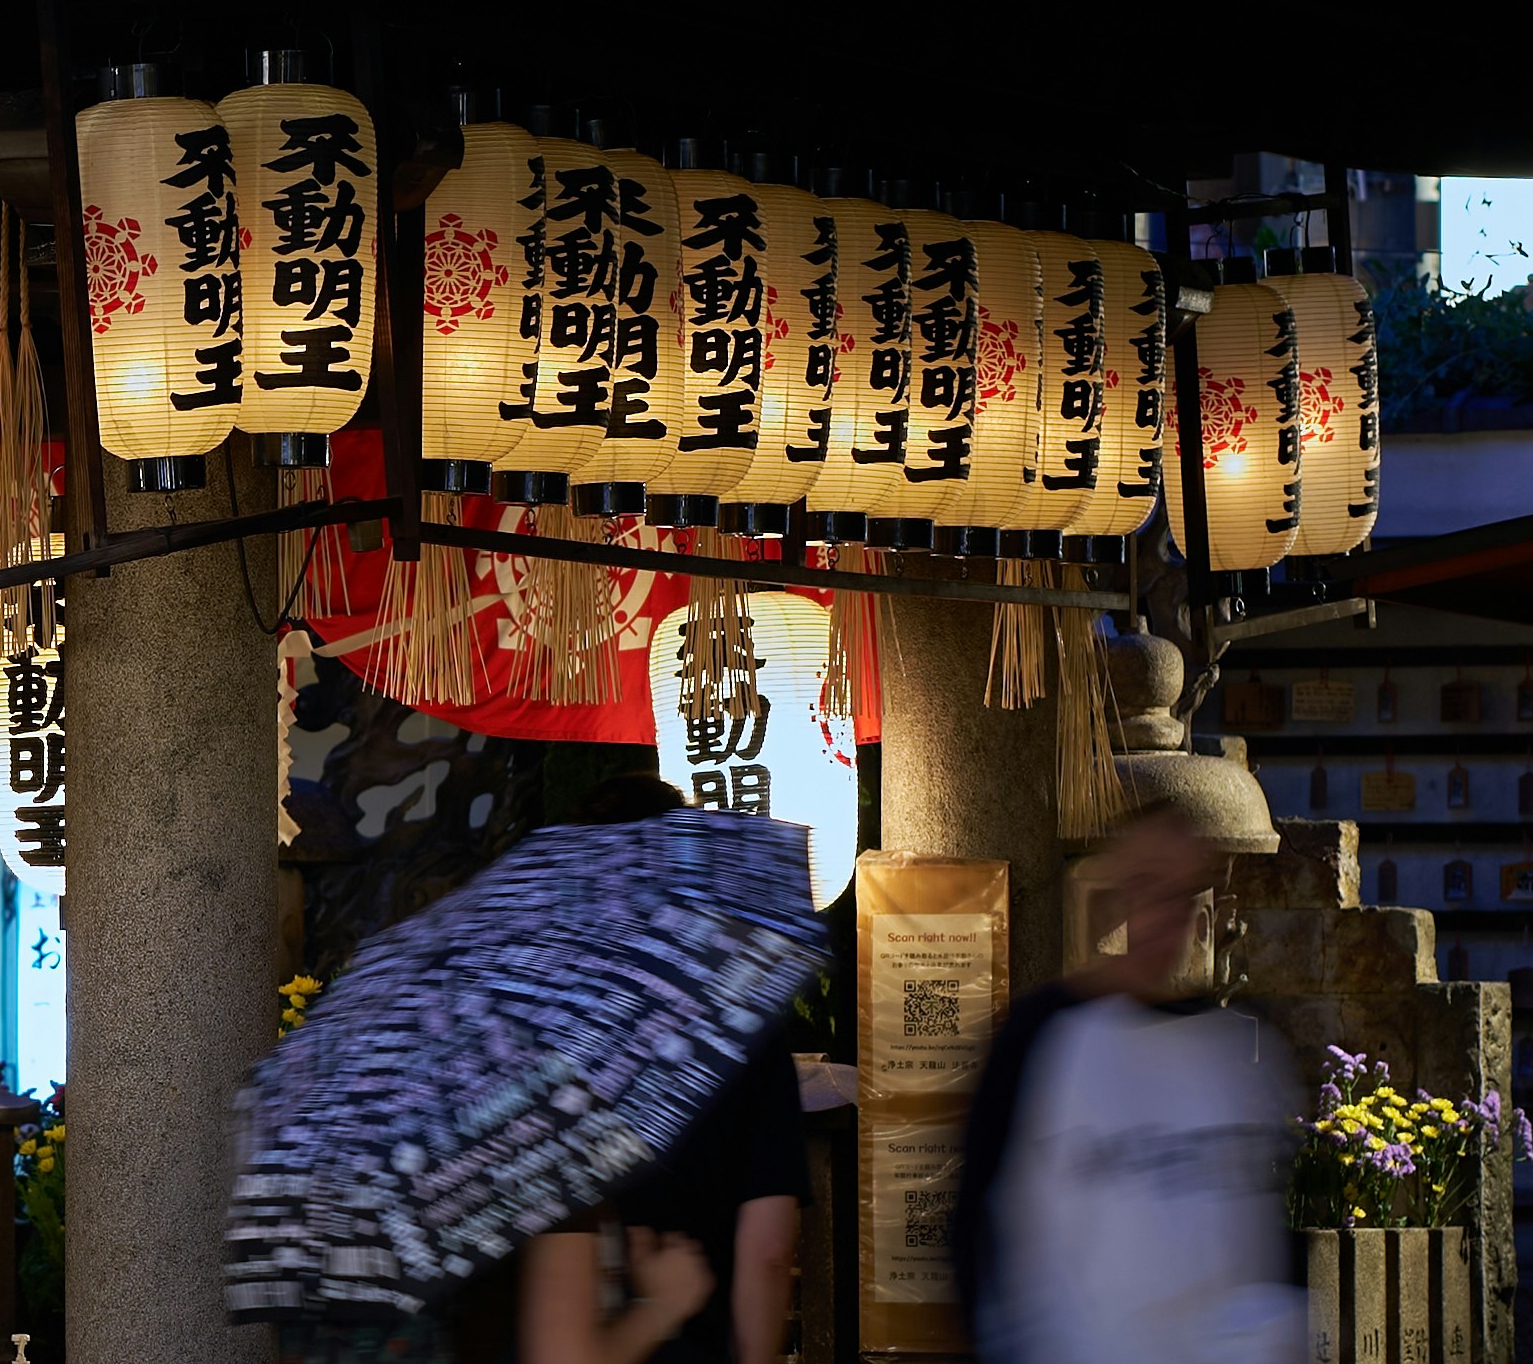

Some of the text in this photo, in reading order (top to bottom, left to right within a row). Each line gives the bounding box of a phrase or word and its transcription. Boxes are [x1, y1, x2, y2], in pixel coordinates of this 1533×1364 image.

[161, 125, 243, 411] 不動明王
[253, 114, 371, 392] 不動明王
[533, 165, 621, 428] 不動明王
[678, 193, 766, 452] 不動明王
[904, 237, 979, 483] 不動明王
[887, 932, 977, 944] Scan right now!!
[887, 1060, 914, 1070] 浄土宗
[888, 1143, 916, 1153] Scan
[918, 1143, 947, 1155] right
